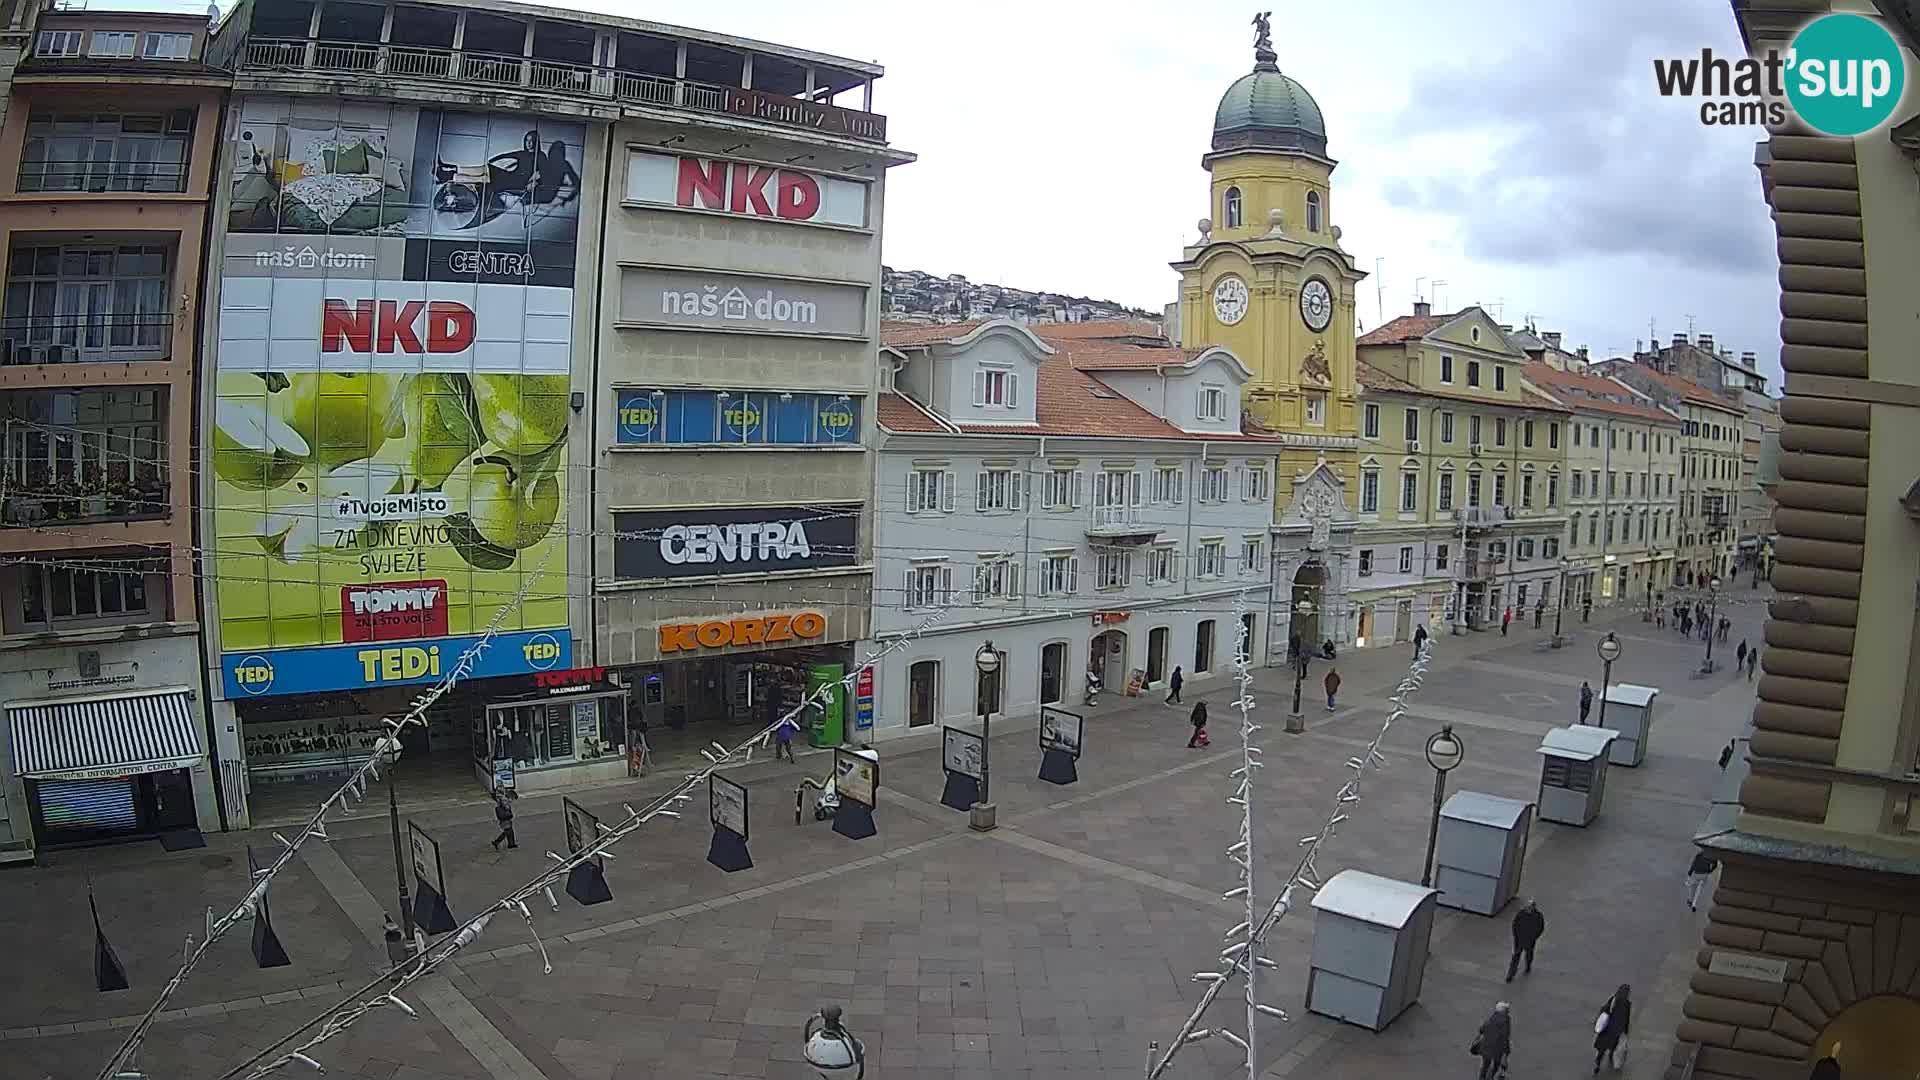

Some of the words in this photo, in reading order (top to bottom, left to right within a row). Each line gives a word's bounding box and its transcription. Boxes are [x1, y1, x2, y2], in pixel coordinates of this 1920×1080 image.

[676, 157, 821, 221] NKD
[255, 246, 295, 268] naš
[321, 248, 367, 269] dom
[449, 249, 536, 276] CENTRA
[662, 285, 719, 317] naš
[754, 291, 817, 323] dom
[321, 298, 478, 354] NKD
[620, 408, 658, 425] TEDi
[724, 410, 760, 426] TEDi
[820, 411, 853, 427] TEDi
[339, 498, 447, 516] #TvojeMisto
[334, 528, 359, 549] ZA
[366, 524, 452, 548] DNEVNO
[660, 521, 811, 564] CENTRA
[360, 547, 427, 575] SVJEŽE
[350, 589, 437, 615] TOMMY
[660, 612, 826, 653] KORZO
[358, 645, 441, 682] TEDi
[523, 644, 560, 660] TEDi
[234, 666, 274, 684] TEDi
[87, 765, 145, 778] INFORMATIVNI
[146, 761, 178, 772] CENTAR
